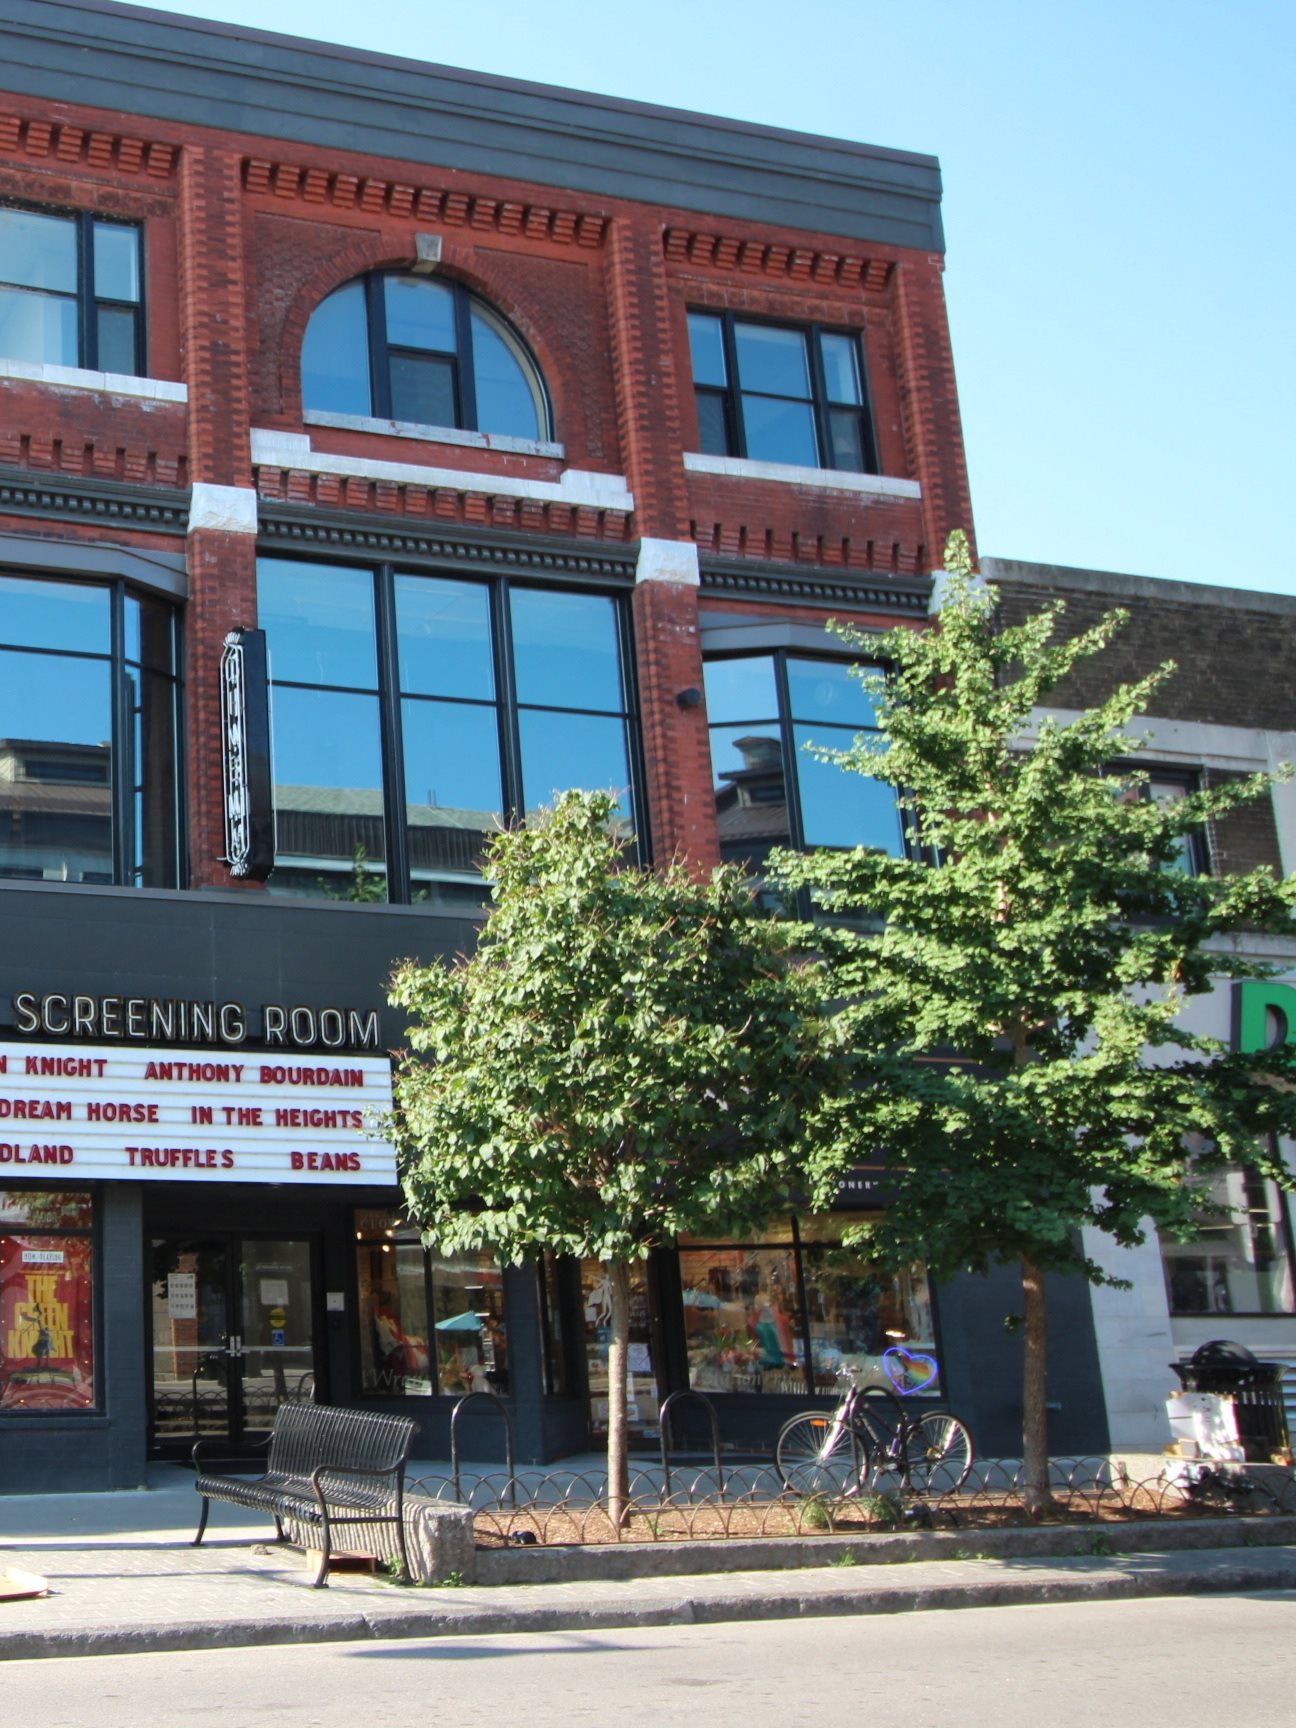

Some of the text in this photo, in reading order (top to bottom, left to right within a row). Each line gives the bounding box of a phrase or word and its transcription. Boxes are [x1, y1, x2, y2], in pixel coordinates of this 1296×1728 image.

[15, 990, 246, 1044] SCREENING
[264, 1004, 381, 1048] ROOM
[25, 1056, 107, 1077] KNIGHT
[145, 1062, 364, 1088] ANTHONY BOURDAIN
[87, 1102, 160, 1123] HORSE
[191, 1106, 363, 1129] IN THE HEIGHTS
[125, 1146, 234, 1169] TRUFFLES
[290, 1151, 361, 1172] BEANS
[25, 1275, 58, 1303] THE
